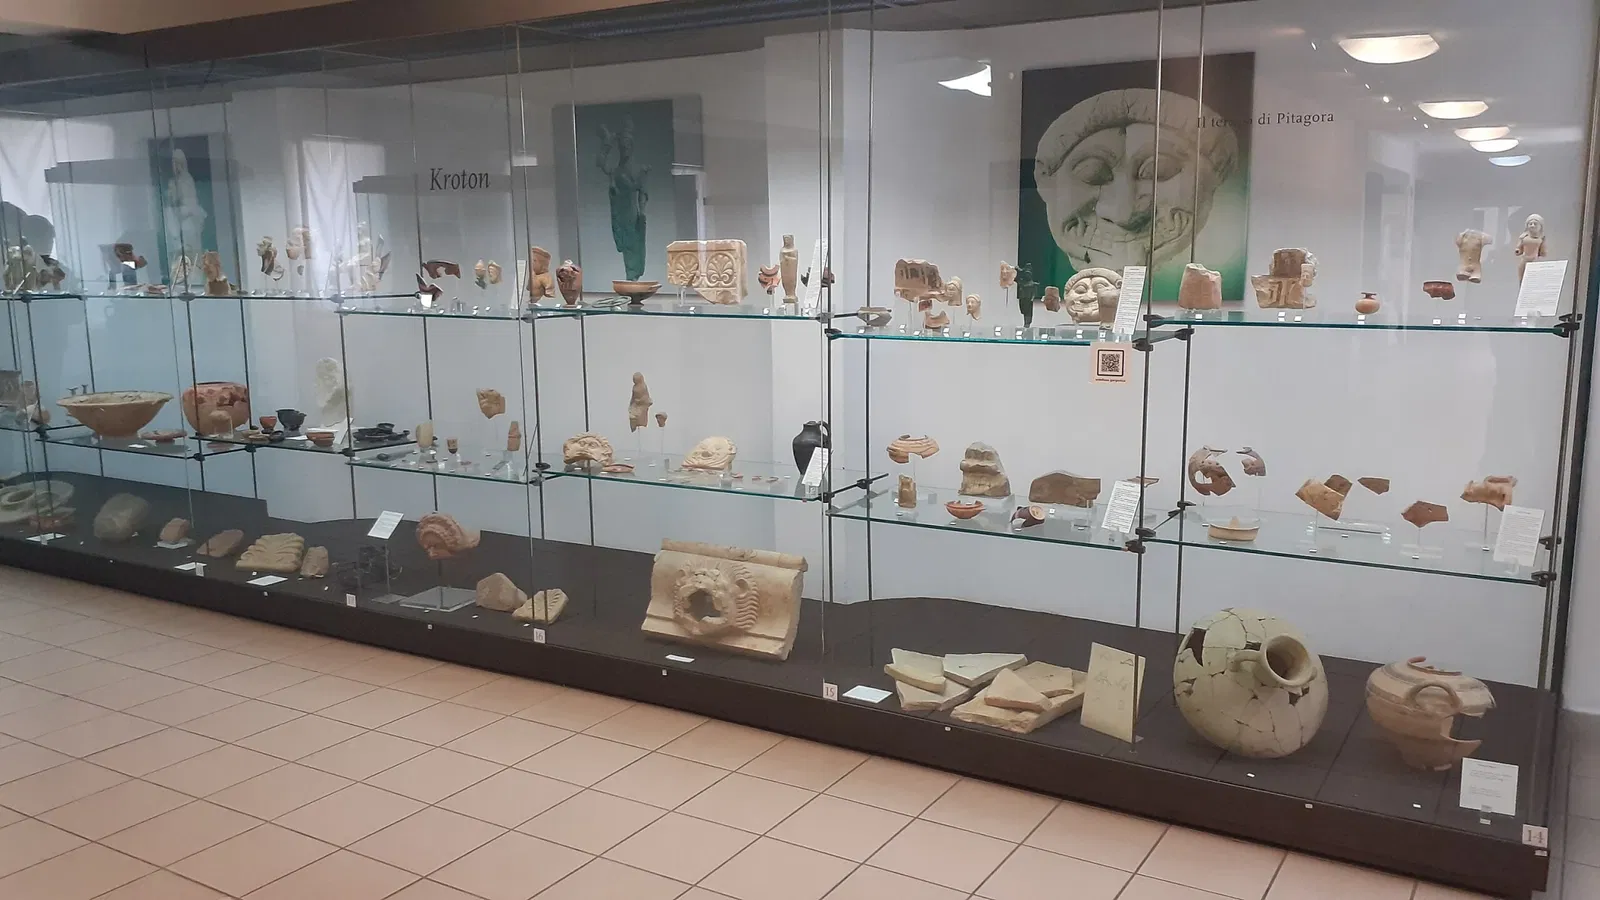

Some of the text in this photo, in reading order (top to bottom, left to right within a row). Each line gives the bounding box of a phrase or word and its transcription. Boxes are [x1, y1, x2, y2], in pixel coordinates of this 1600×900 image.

[1257, 112, 1271, 125] di
[1276, 112, 1335, 127] Pitagora
[430, 167, 490, 190] Kroton
[535, 631, 544, 641] 16
[825, 686, 835, 697] 15
